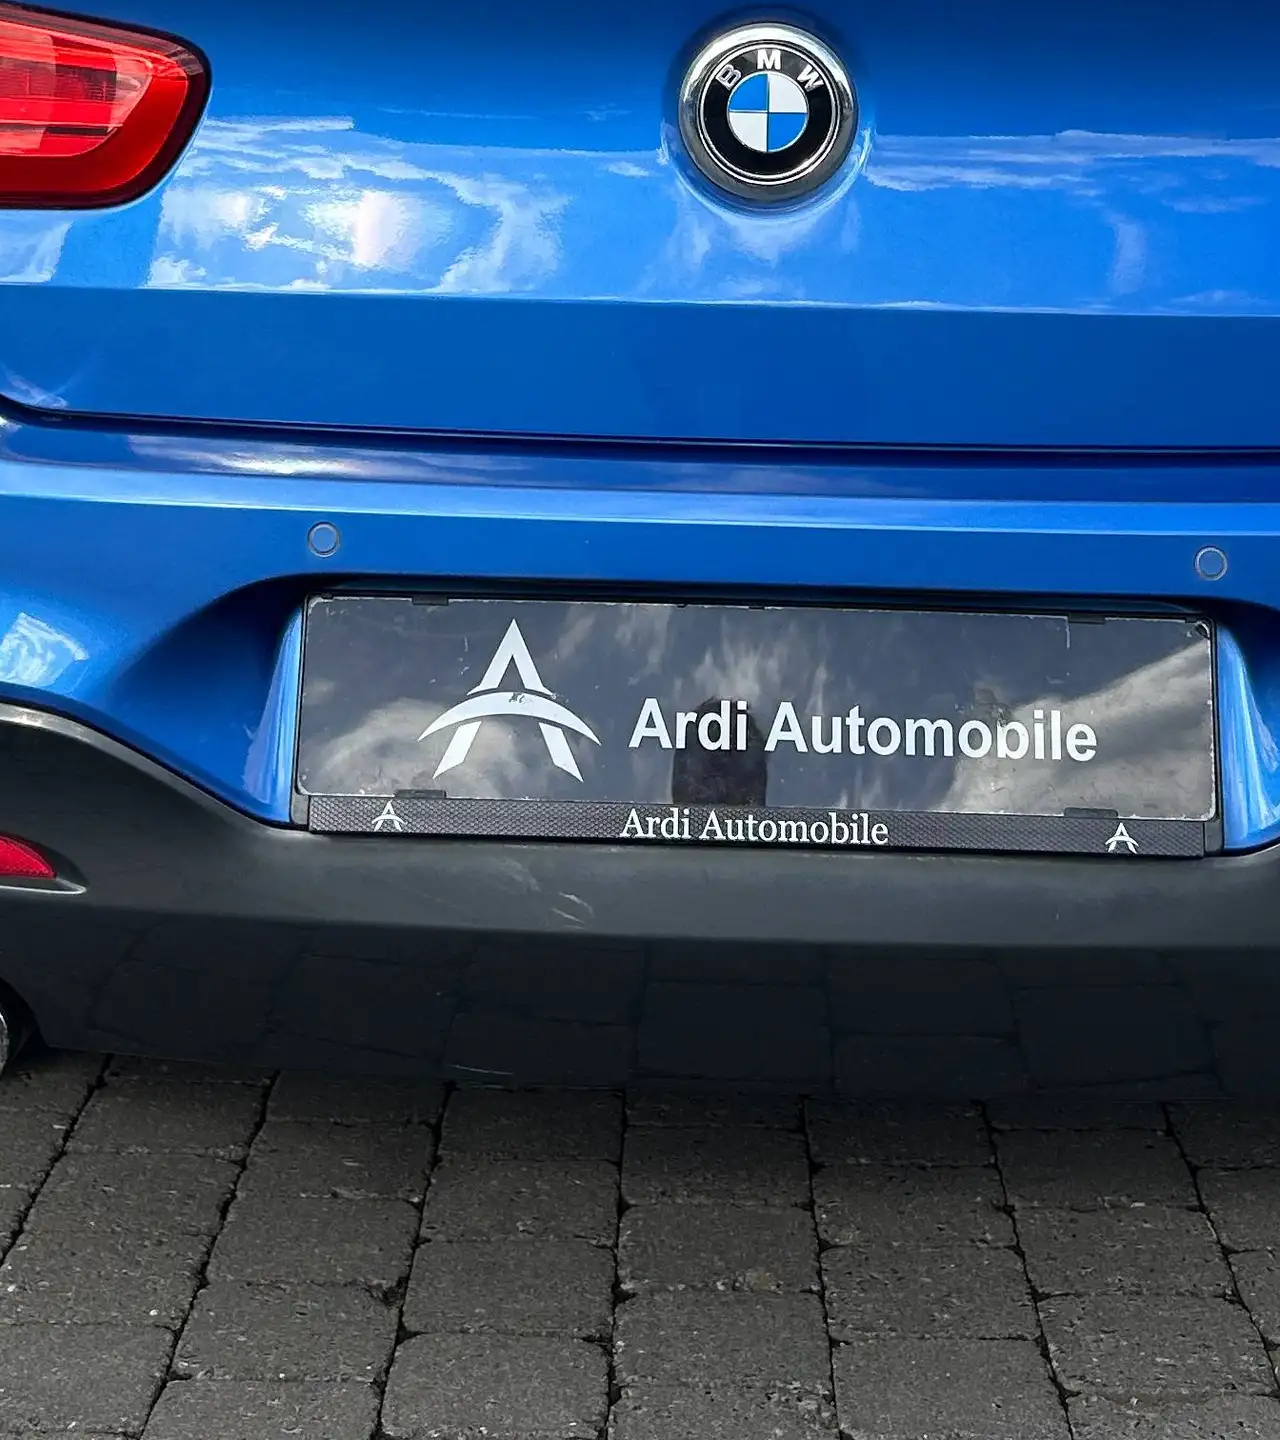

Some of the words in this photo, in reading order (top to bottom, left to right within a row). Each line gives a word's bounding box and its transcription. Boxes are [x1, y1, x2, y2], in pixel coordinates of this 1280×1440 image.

[715, 48, 825, 92] BMW
[628, 698, 749, 753] Ardi
[767, 702, 1099, 763] Automobile
[620, 807, 692, 841] Ardi
[700, 811, 891, 847] Automobile
